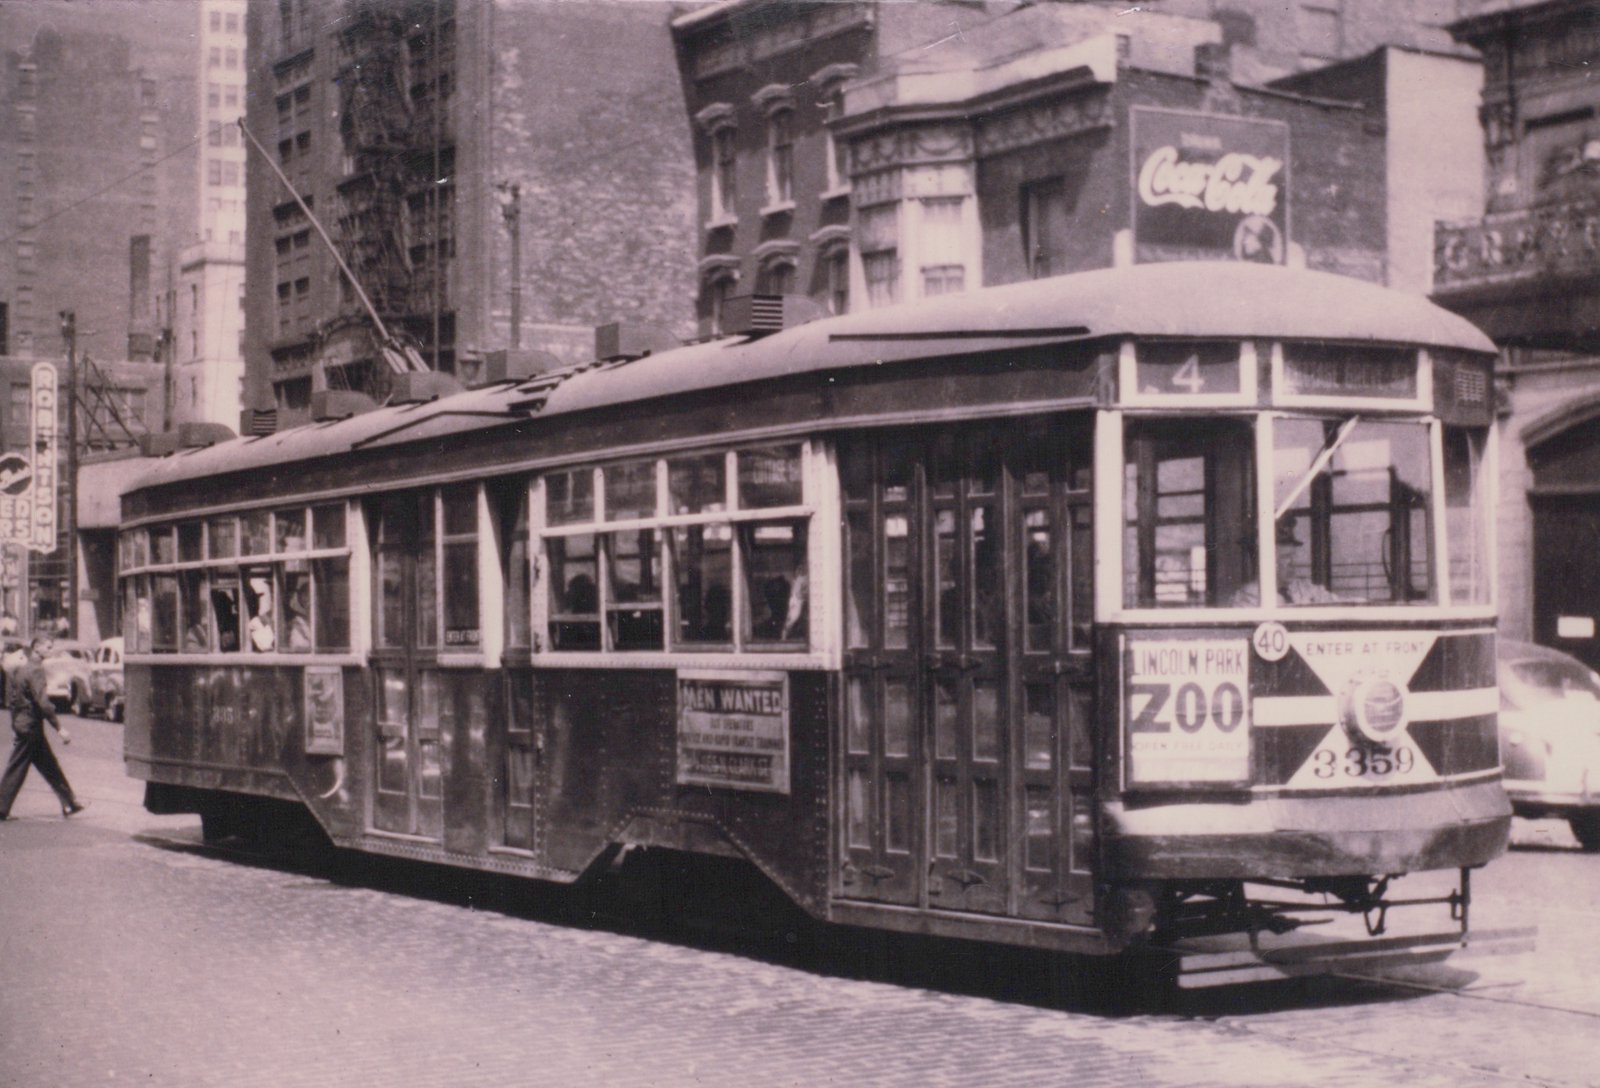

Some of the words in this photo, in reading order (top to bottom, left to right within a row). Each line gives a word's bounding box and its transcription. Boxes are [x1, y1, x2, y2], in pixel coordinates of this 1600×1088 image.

[1172, 354, 1205, 394] 4
[1258, 631, 1285, 653] 40
[1306, 643, 1352, 656] ENTER
[1362, 643, 1377, 654] AT
[1387, 641, 1425, 654] FRONT
[1133, 649, 1198, 675] LINCOLN
[1205, 648, 1244, 675] PARK
[683, 686, 715, 709] MEN
[720, 688, 781, 713] WANTED
[1131, 682, 1243, 733] ZOO
[1314, 747, 1414, 778] 3359
